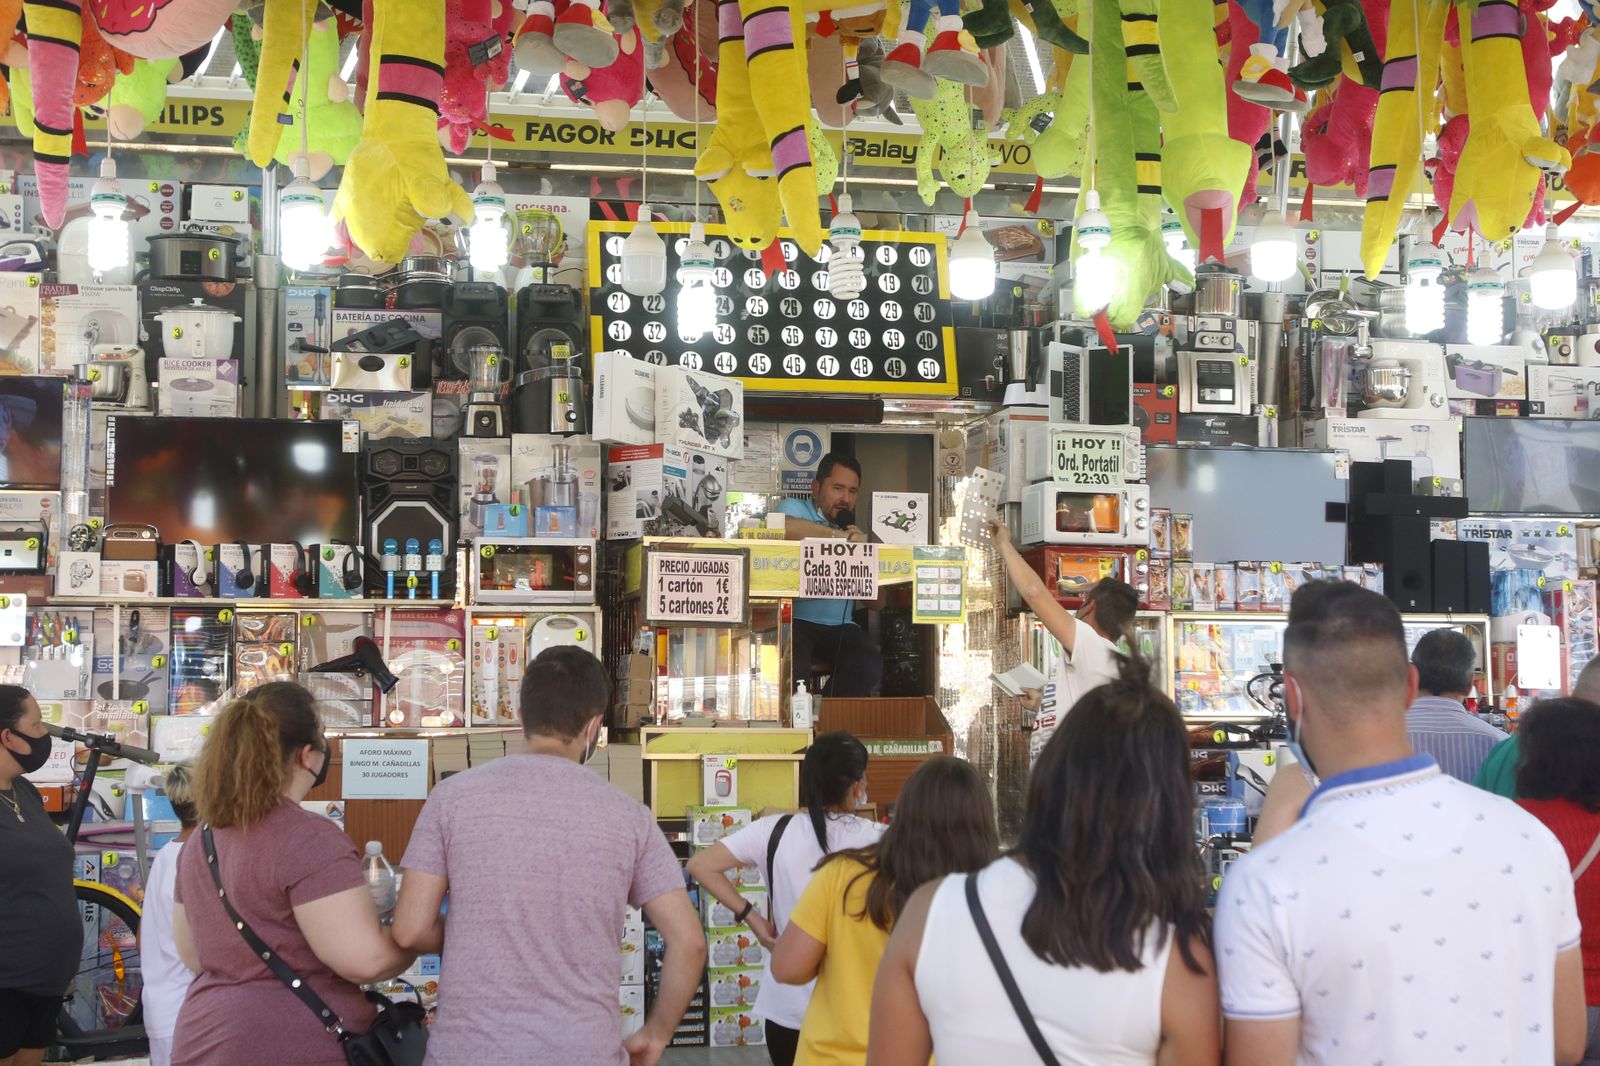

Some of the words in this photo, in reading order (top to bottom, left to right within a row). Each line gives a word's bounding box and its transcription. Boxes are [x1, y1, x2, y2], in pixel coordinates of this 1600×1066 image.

[153, 104, 225, 126] ILIPS
[525, 122, 615, 145] FAGOR
[849, 138, 918, 164] Balay
[151, 183, 158, 192] 3
[234, 191, 241, 200] 3
[524, 226, 530, 234] 2
[1041, 222, 1046, 230] 8
[1504, 240, 1509, 248] 5
[212, 250, 218, 258] 6
[614, 238, 619, 254] 1
[714, 242, 722, 257] 4
[884, 246, 890, 263] 9
[914, 249, 925, 264] 10
[30, 276, 36, 285] 5
[715, 269, 728, 285] 14
[750, 270, 762, 286] 15
[784, 272, 795, 288] 16
[817, 272, 828, 288] 17
[884, 274, 895, 291] 19
[916, 276, 928, 292] 20
[612, 294, 624, 310] 21
[647, 295, 661, 312] 22
[716, 296, 730, 313] 24
[751, 298, 763, 315] 25
[784, 299, 798, 316] 26
[818, 301, 830, 317] 27
[852, 302, 864, 318] 28
[885, 303, 898, 319] 29
[918, 304, 931, 320] 30
[336, 312, 371, 321] BATERÍA
[388, 314, 426, 322] COCINA
[174, 328, 180, 338] 3
[614, 323, 626, 340] 31
[648, 324, 661, 340] 32
[718, 326, 731, 342] 34
[752, 326, 765, 343] 35
[786, 328, 798, 344] 36
[820, 330, 832, 346] 37
[853, 330, 866, 346] 38
[887, 332, 900, 348] 39
[919, 332, 933, 348] 40
[400, 358, 406, 368] 4
[490, 356, 496, 366] 6
[649, 352, 662, 366] 42
[683, 354, 697, 370] 43
[719, 354, 732, 372] 44
[752, 356, 766, 372] 45
[786, 358, 800, 373] 46
[820, 358, 834, 374] 47
[854, 360, 868, 376] 48
[887, 361, 902, 377] 49
[923, 362, 936, 378] 50
[92, 370, 98, 380] 7
[559, 392, 568, 402] 10
[1168, 388, 1174, 396] 3
[327, 393, 364, 403] DHG
[1268, 408, 1274, 416] 5
[1072, 438, 1106, 449] HOY
[1058, 452, 1078, 471] Ord.
[1082, 454, 1119, 472] Portatil
[1073, 472, 1110, 484] 22:30
[92, 520, 98, 528] 3
[1561, 526, 1568, 536] 6
[28, 540, 36, 548] 2
[486, 546, 492, 556] 8
[820, 544, 858, 557] HOY
[1139, 551, 1146, 560] 8
[660, 560, 690, 573] PRECIO
[692, 561, 730, 574] JUGADAS
[804, 560, 832, 577] Cada
[834, 560, 848, 577] 30
[850, 562, 873, 578] min.
[878, 560, 910, 574] ILLAS
[409, 578, 414, 588] 1
[658, 579, 664, 592] 1
[668, 577, 703, 593] cartón
[716, 578, 729, 594] 1€
[805, 579, 834, 596] JUGADAS
[836, 578, 873, 597] ESPECIALES
[1539, 578, 1545, 587] 2
[659, 598, 666, 614] 5
[668, 599, 714, 615] cartones
[716, 599, 729, 616] 2€
[223, 611, 228, 622] 1
[308, 617, 312, 626] 1
[68, 632, 73, 642] 1
[490, 630, 495, 640] 1
[578, 630, 584, 640] 1
[284, 646, 290, 656] 1
[451, 642, 456, 650] 1
[156, 657, 162, 666] 1
[138, 704, 143, 713] 1
[883, 740, 928, 754] CAÑADILLAS
[108, 854, 113, 864] 1
